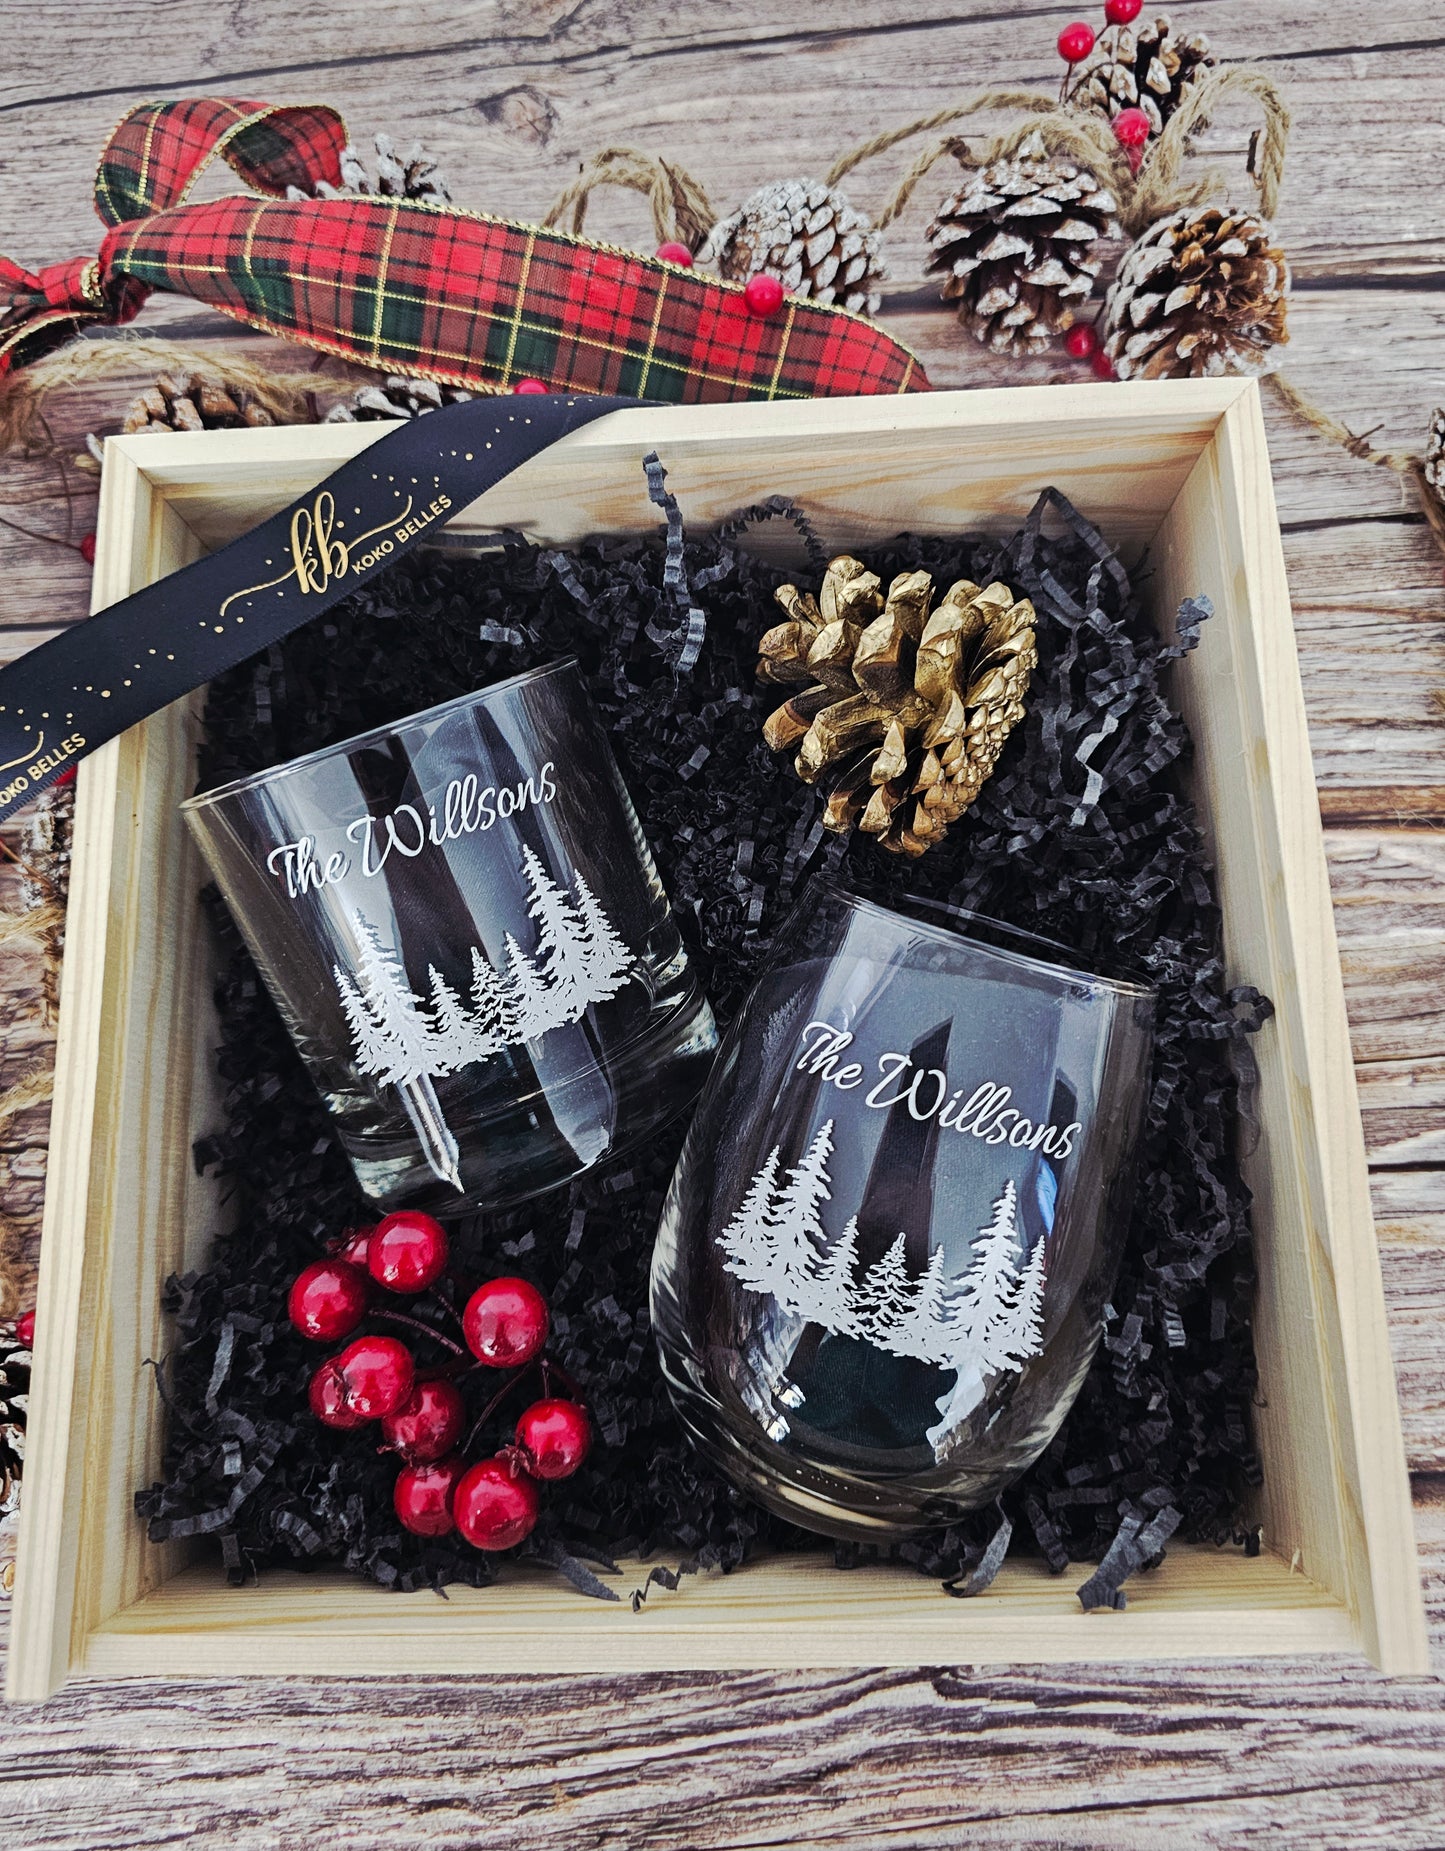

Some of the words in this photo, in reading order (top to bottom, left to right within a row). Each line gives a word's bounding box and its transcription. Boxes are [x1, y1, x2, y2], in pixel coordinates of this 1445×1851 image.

[351, 539, 395, 576] KOKO
[394, 494, 453, 544] BELLES
[0, 776, 29, 808] OKO
[26, 732, 87, 781] BELLES
[266, 836, 351, 899] The
[345, 761, 558, 878] Willsons
[796, 1020, 863, 1090] The
[864, 1052, 1083, 1160] Willsons
